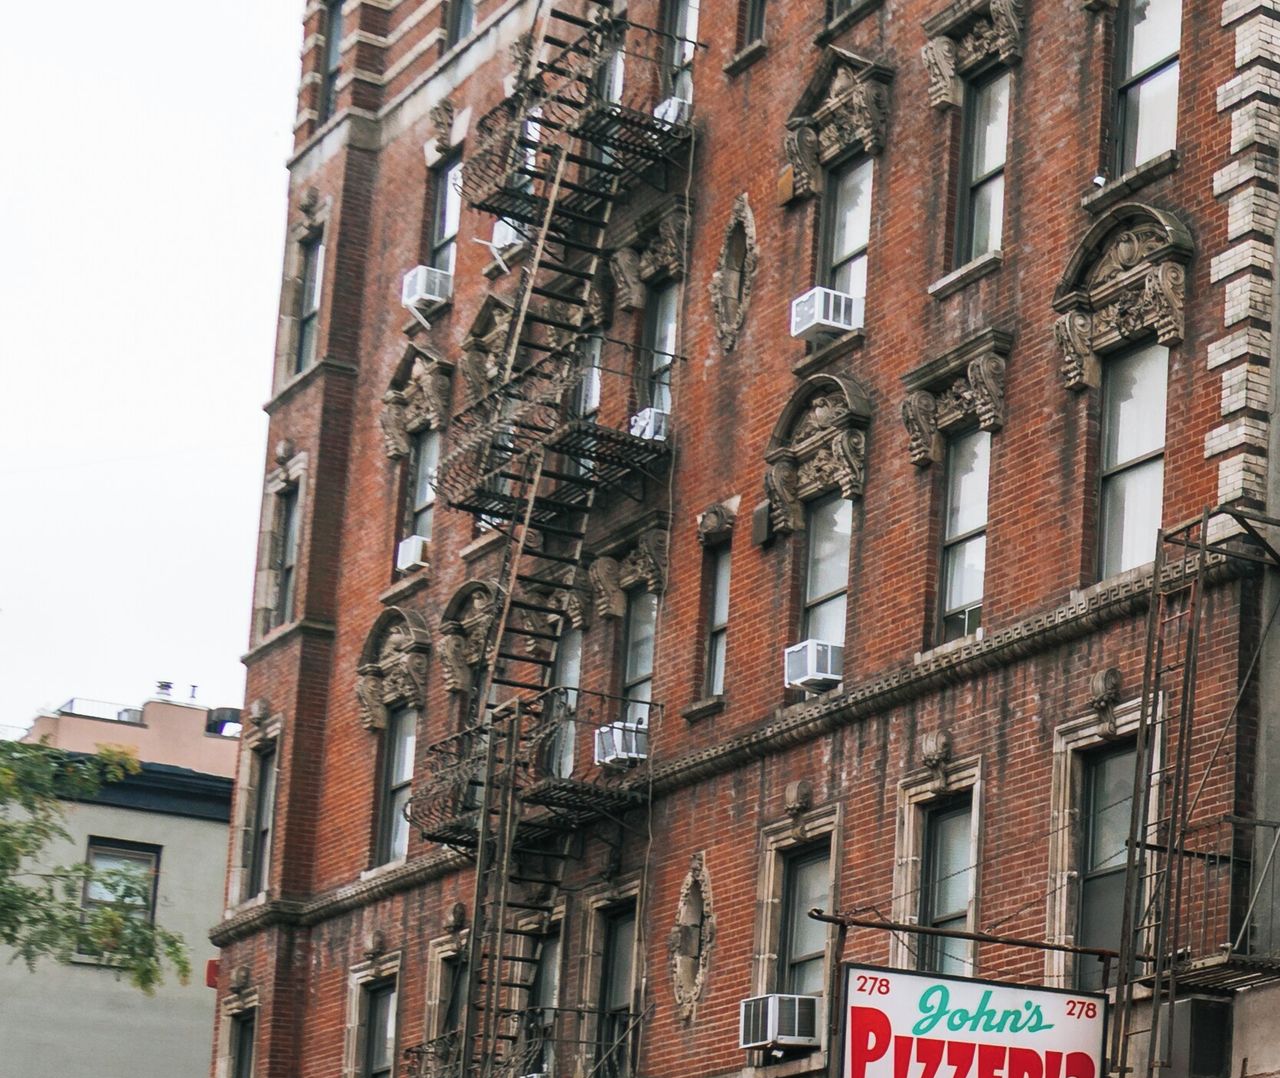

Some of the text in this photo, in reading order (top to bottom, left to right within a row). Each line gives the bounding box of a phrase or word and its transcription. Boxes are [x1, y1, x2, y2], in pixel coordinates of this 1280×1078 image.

[856, 975, 891, 995] 278
[911, 984, 1055, 1036] John's
[1065, 1000, 1097, 1019] 278
